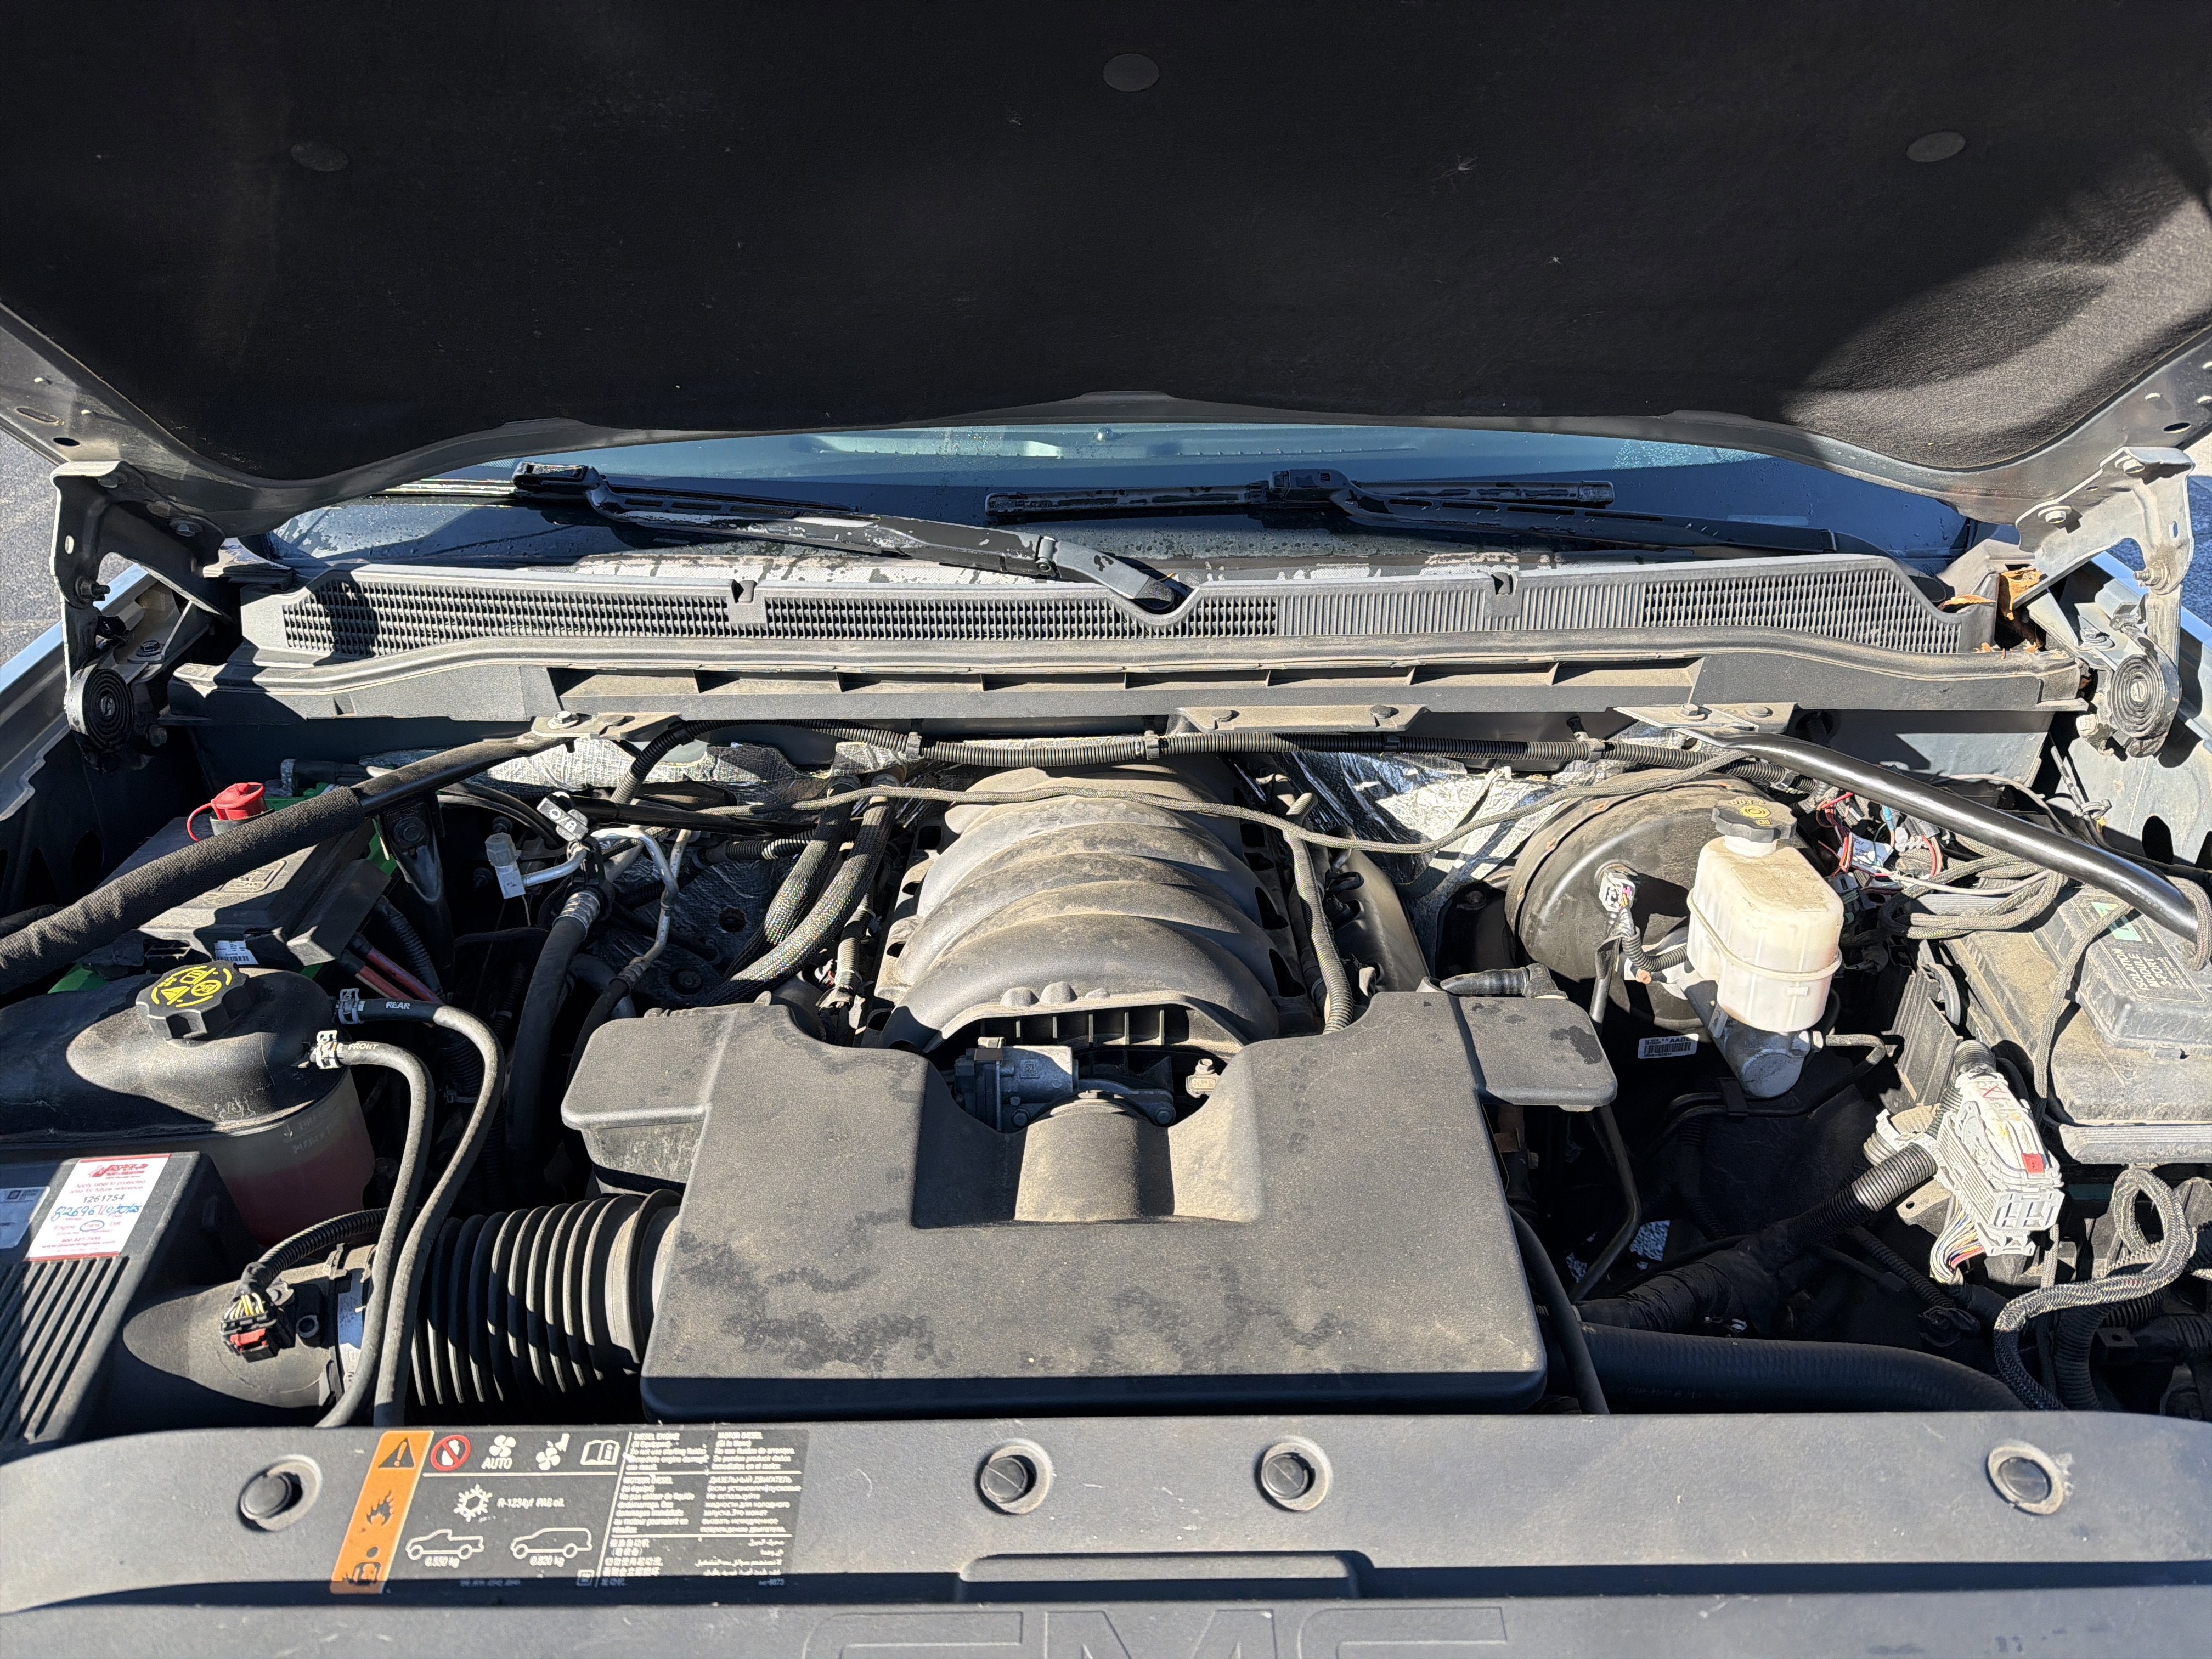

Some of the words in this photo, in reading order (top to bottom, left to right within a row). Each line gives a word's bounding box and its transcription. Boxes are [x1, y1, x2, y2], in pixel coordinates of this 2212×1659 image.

[2112, 947, 2150, 991] ISOLATION
[2128, 953, 2162, 989] MODULE
[2141, 956, 2173, 987] 3-PORT
[385, 1001, 411, 1010] REAR
[83, 1194, 125, 1203] 1261754
[656, 1432, 680, 1440] ENGINE
[741, 1431, 763, 1440] DIESEL
[662, 1448, 686, 1457] starting
[481, 1457, 513, 1469] AUTO
[661, 1456, 682, 1464] engine
[651, 1476, 674, 1485] DIESEL
[709, 1475, 753, 1484] ДИЗЕЛЬНЫЙ
[753, 1476, 793, 1484] ДВИГАТЕЛЬ
